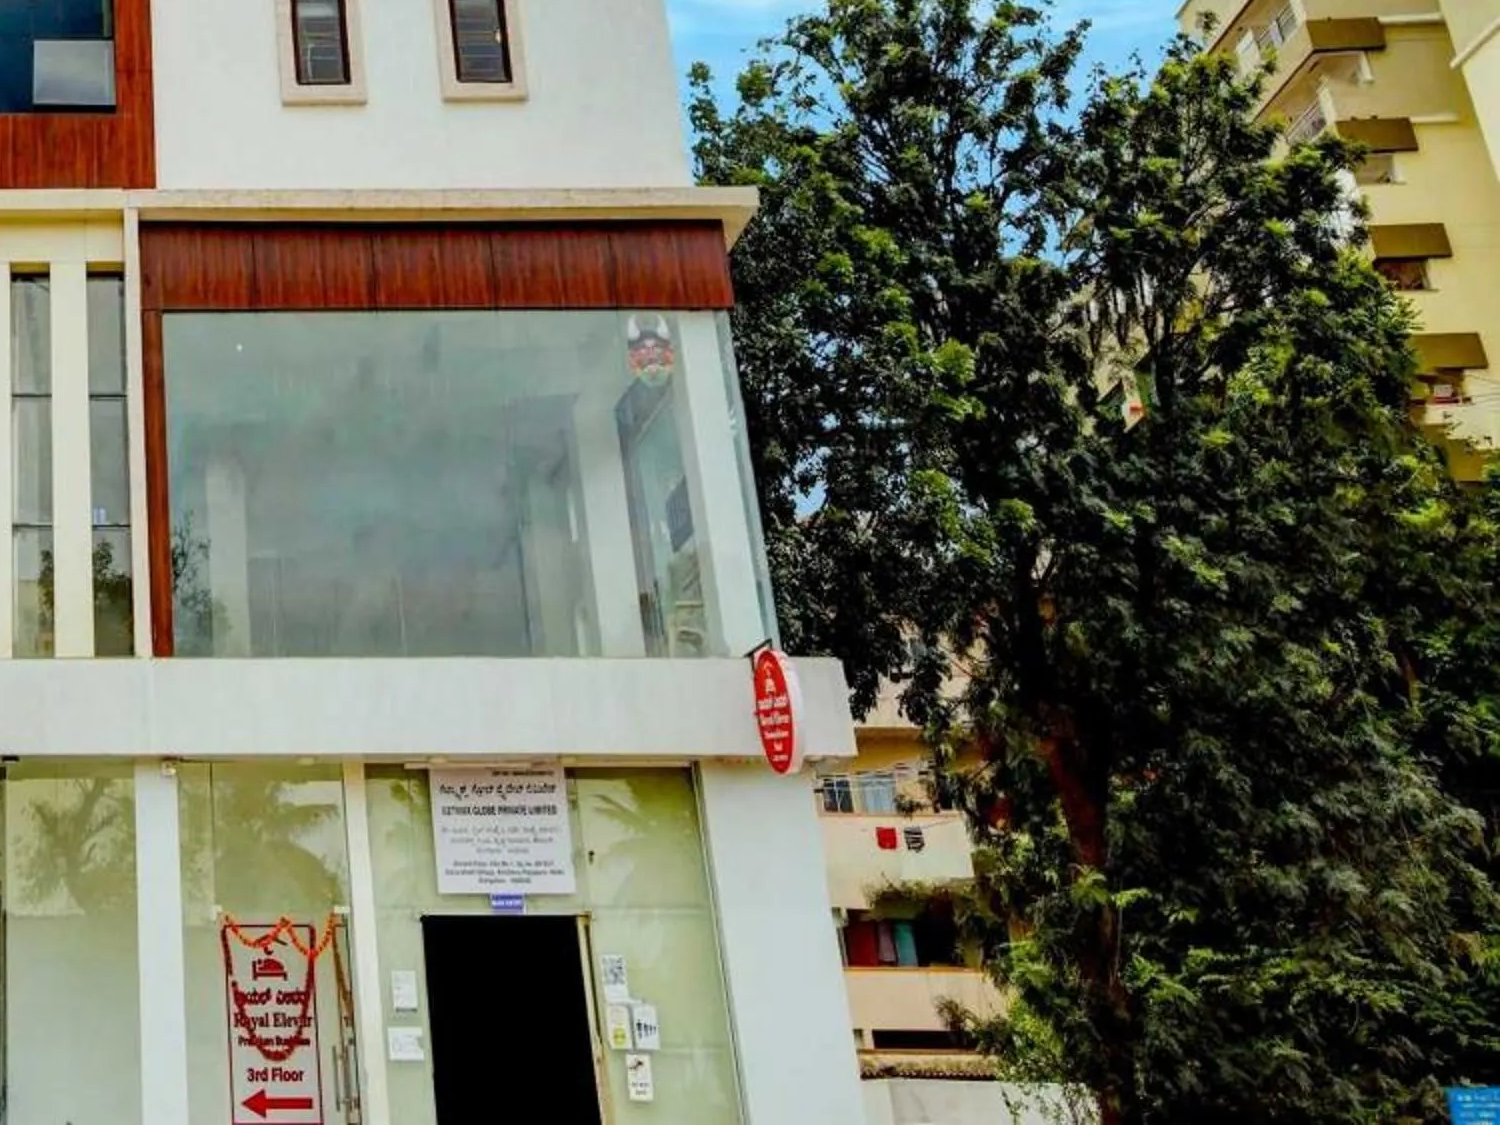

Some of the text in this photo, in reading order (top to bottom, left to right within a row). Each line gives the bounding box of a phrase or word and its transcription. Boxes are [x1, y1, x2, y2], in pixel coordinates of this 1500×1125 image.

[234, 1012, 269, 1030] Royal
[247, 1067, 304, 1082] 3rd Floor
